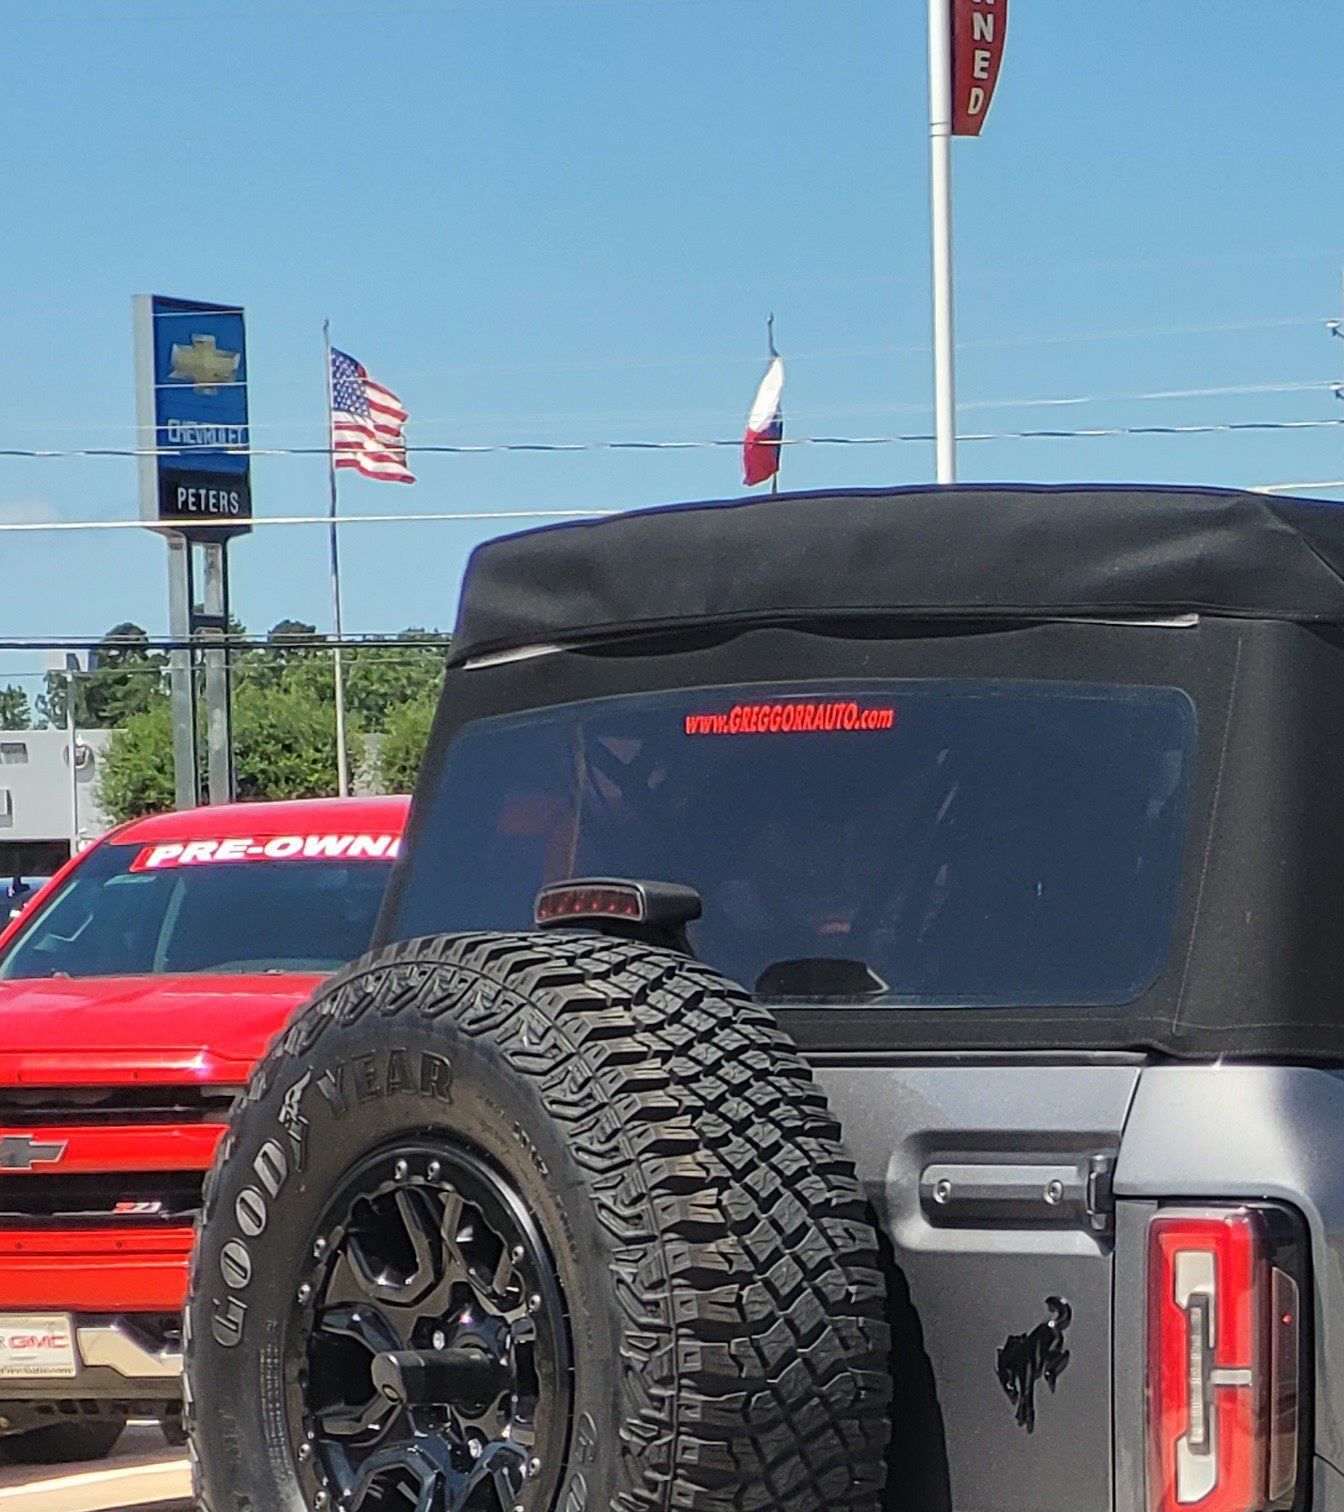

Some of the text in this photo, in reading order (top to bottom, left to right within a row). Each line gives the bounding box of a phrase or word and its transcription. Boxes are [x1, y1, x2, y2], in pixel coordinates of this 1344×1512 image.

[967, 0, 995, 115] NED
[177, 486, 240, 514] PETERS
[685, 703, 893, 735] www.GREGGORRAUTO.com
[8, 1335, 67, 1349] GMC
